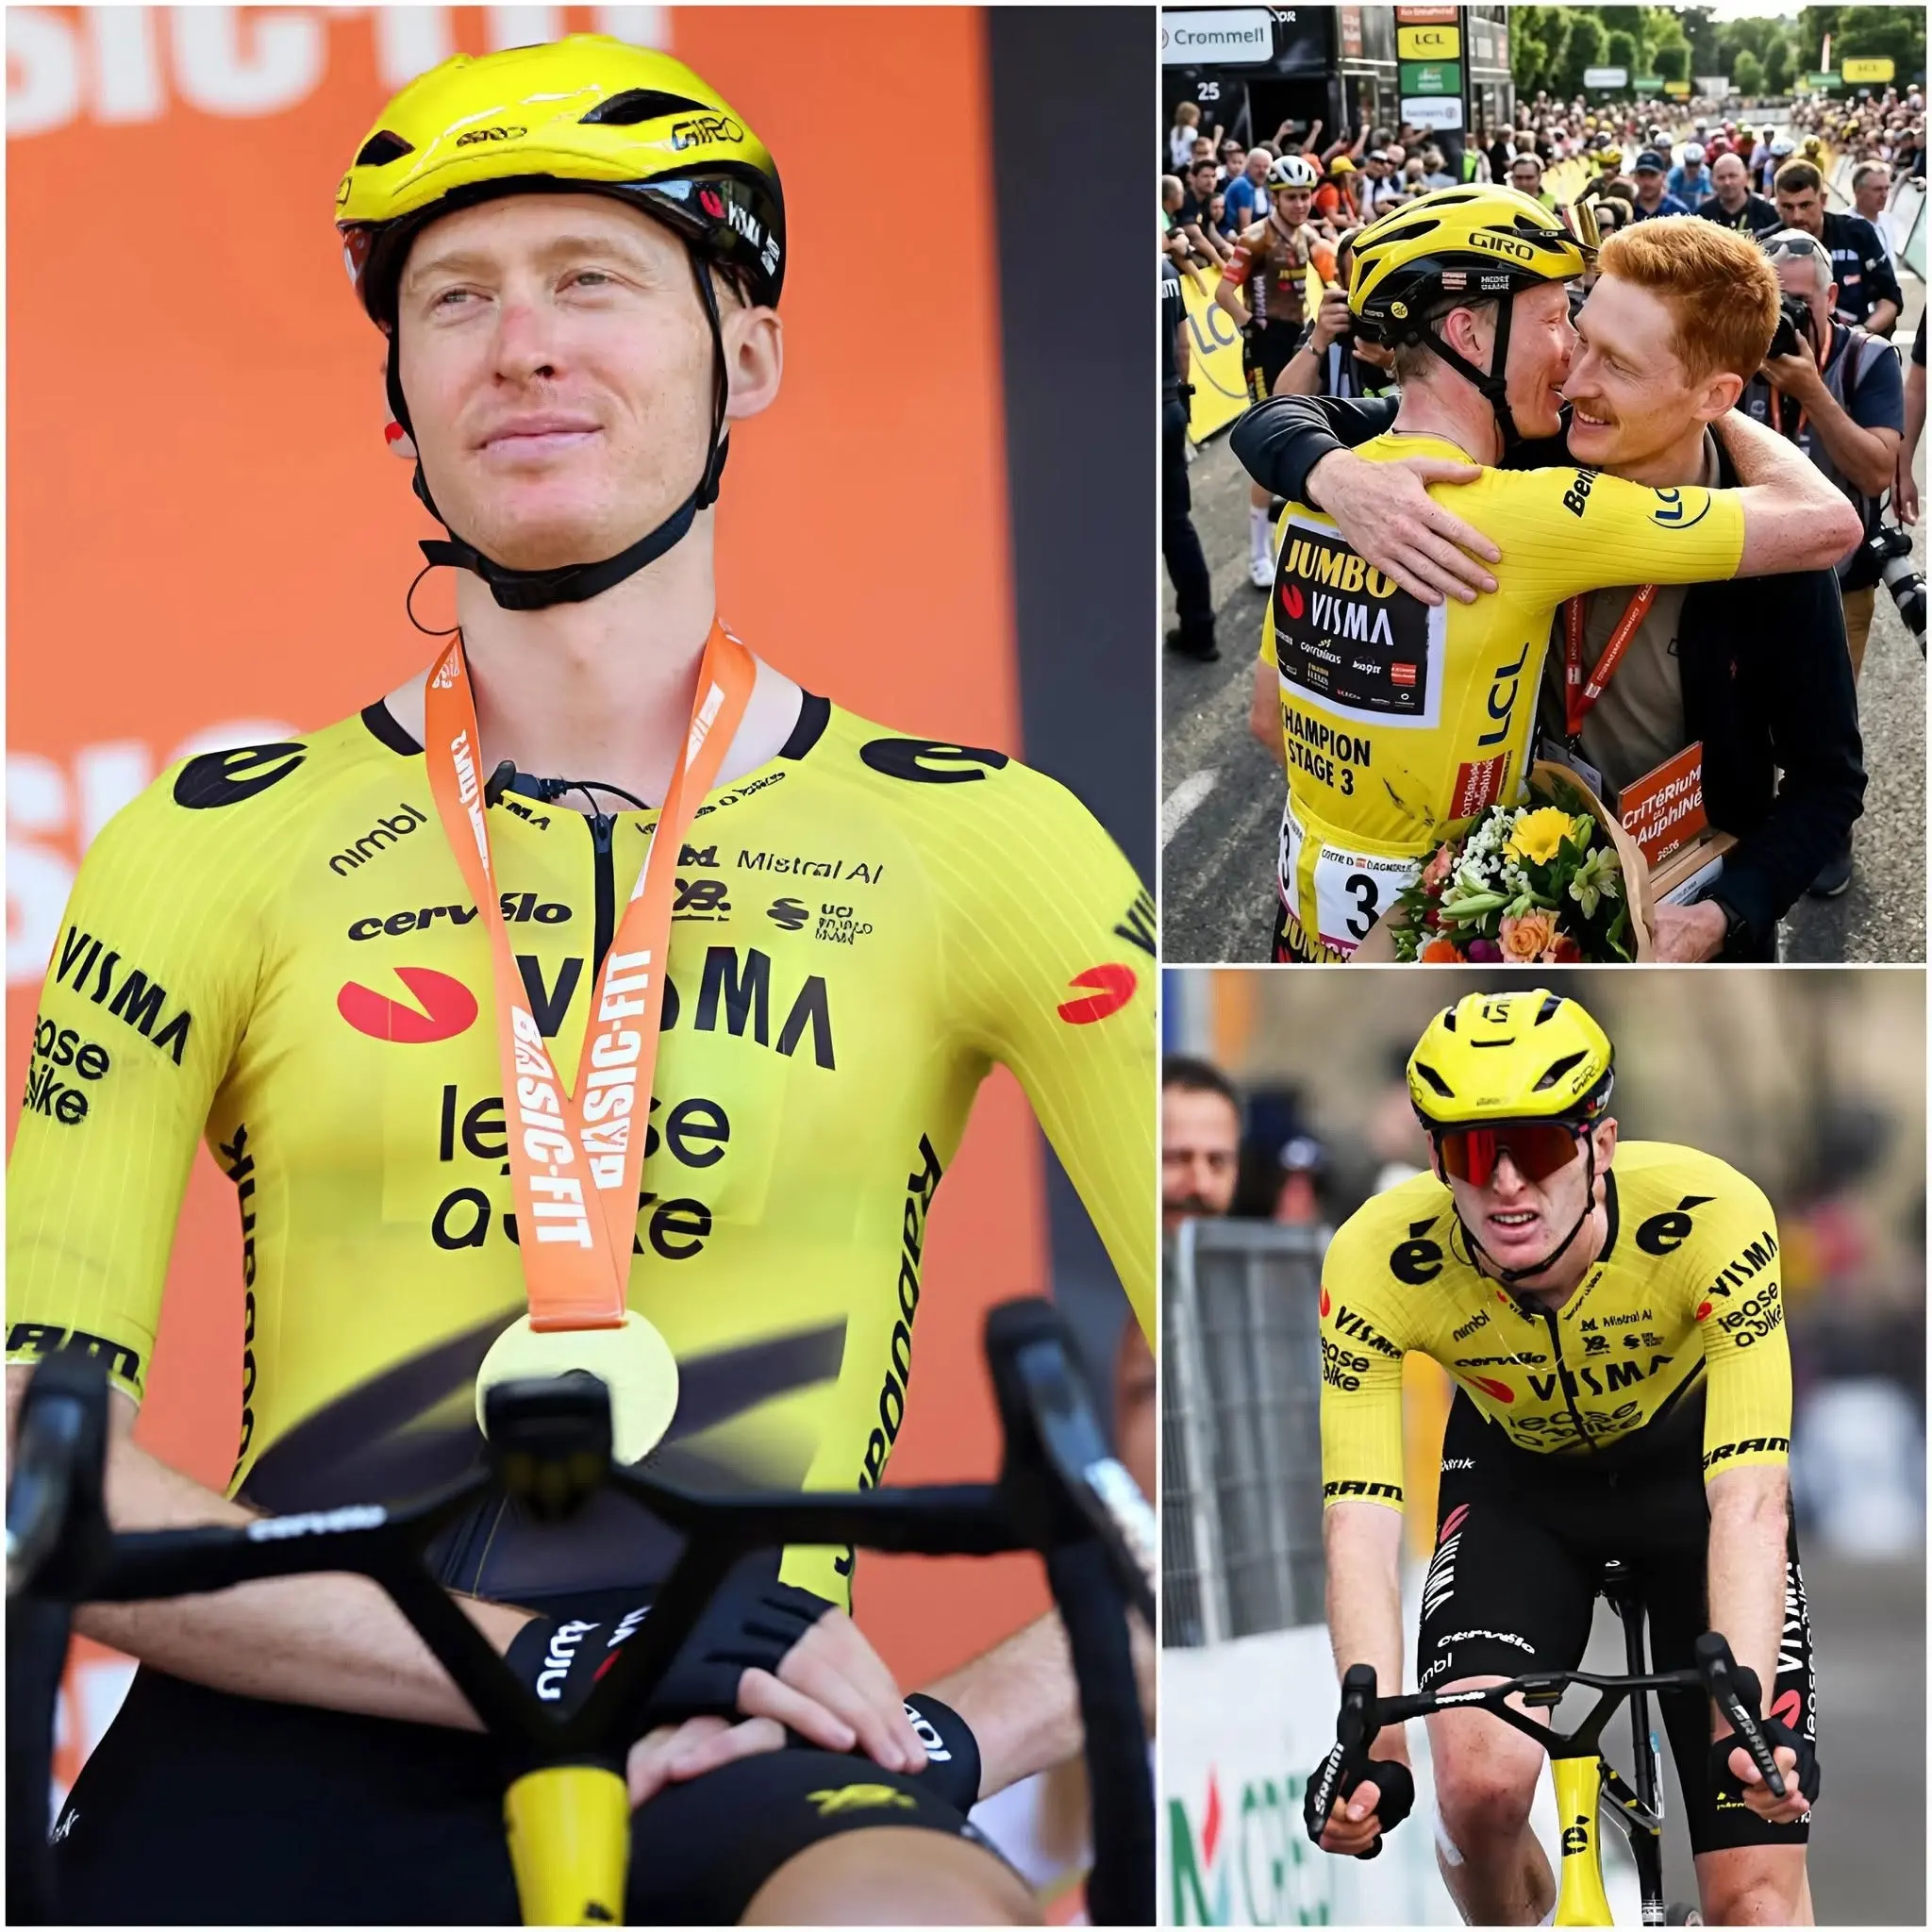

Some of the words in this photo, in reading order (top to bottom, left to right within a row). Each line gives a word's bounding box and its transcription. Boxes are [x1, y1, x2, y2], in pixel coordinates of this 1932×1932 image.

[1415, 33, 1445, 45] LCL
[1197, 82, 1220, 101] 25
[1469, 232, 1534, 261] GIRO
[1188, 302, 1236, 356] LC
[1655, 489, 1683, 520] LC
[1311, 591, 1394, 646] VISMA
[1477, 641, 1530, 747] LCL
[1288, 738, 1334, 789] STAGE
[1341, 768, 1355, 796] 3
[329, 803, 428, 877] nimbl
[1344, 874, 1380, 941] 3
[56, 925, 192, 1067] VISMA
[515, 946, 837, 1072] VMA
[440, 1084, 732, 1169] lee
[1708, 1231, 1778, 1298] VISMA
[1452, 1308, 1491, 1342] nimbl
[1718, 1282, 1778, 1334] lease
[1526, 1355, 1675, 1402] VISMA
[1324, 1480, 1405, 1503] RAM
